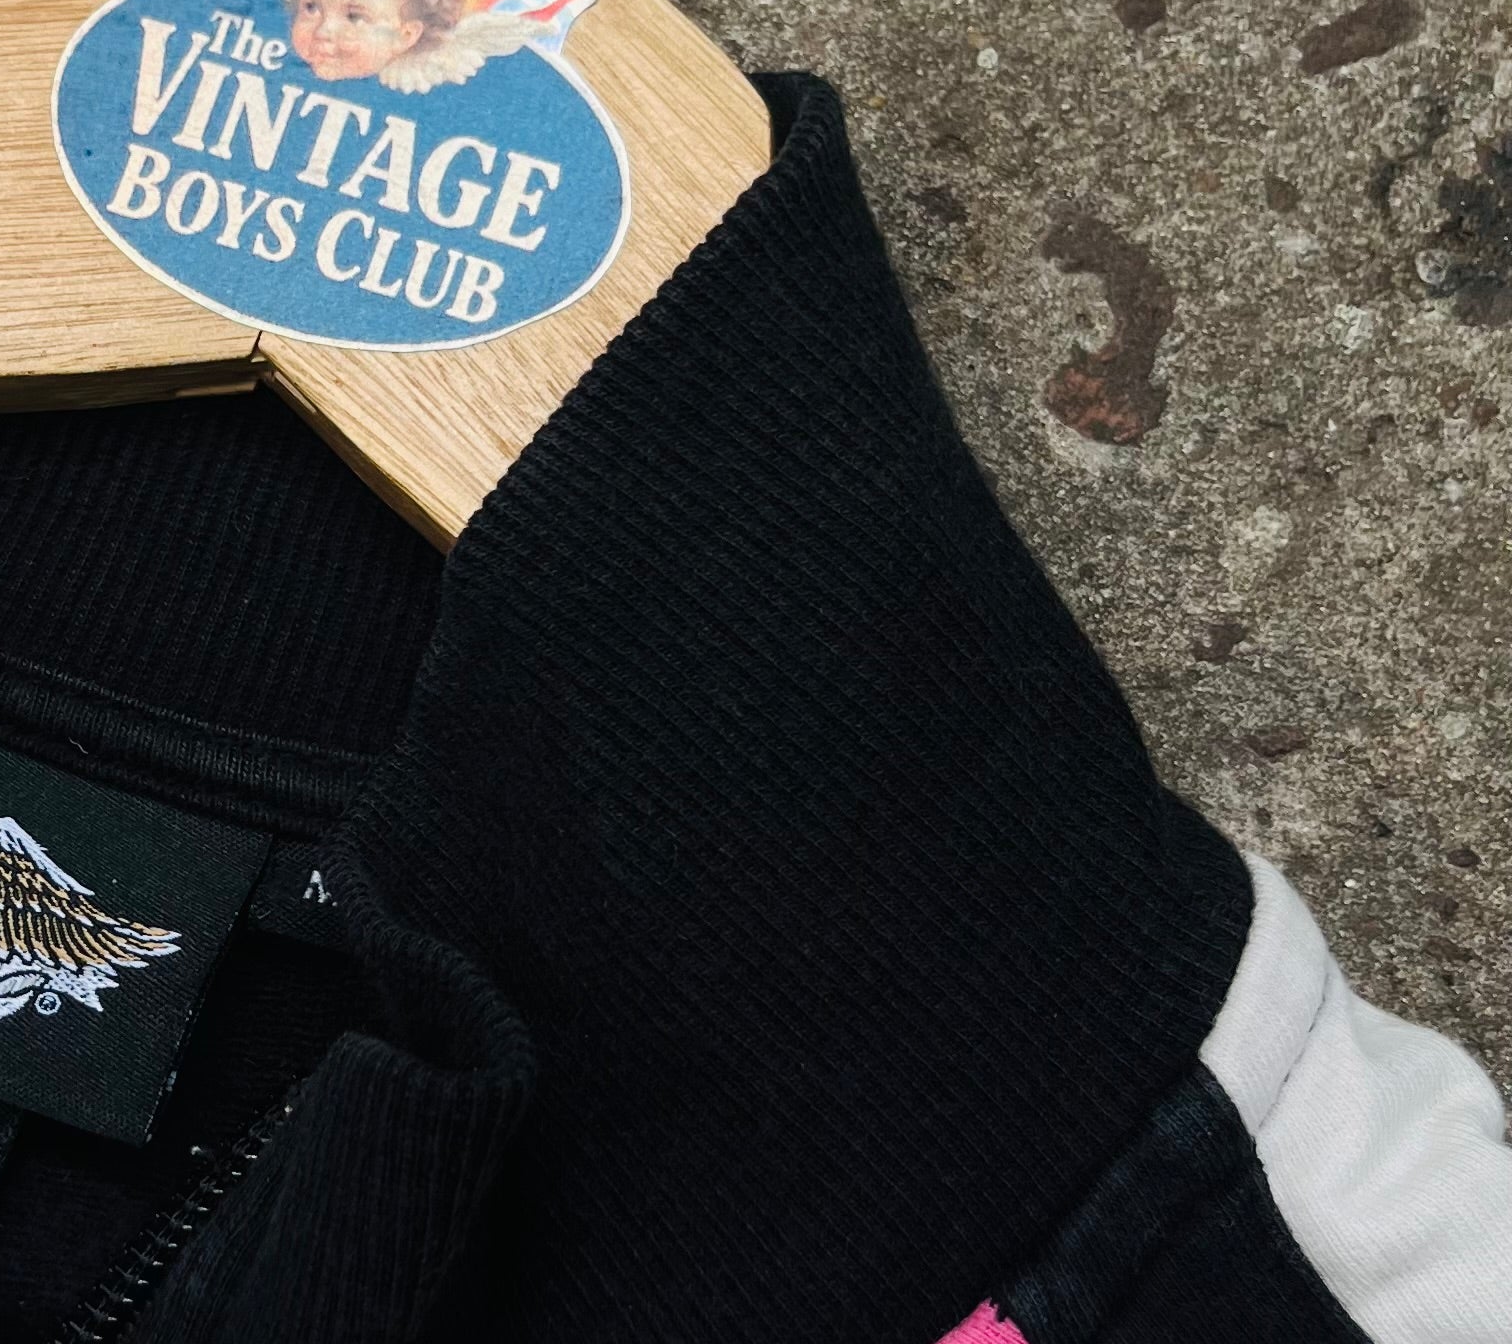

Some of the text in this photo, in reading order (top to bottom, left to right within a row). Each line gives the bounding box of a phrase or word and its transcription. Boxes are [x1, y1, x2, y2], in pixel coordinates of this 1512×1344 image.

[207, 9, 287, 70] The
[130, 18, 561, 252] VINTAGE
[107, 144, 505, 324] BOYS CLUB
